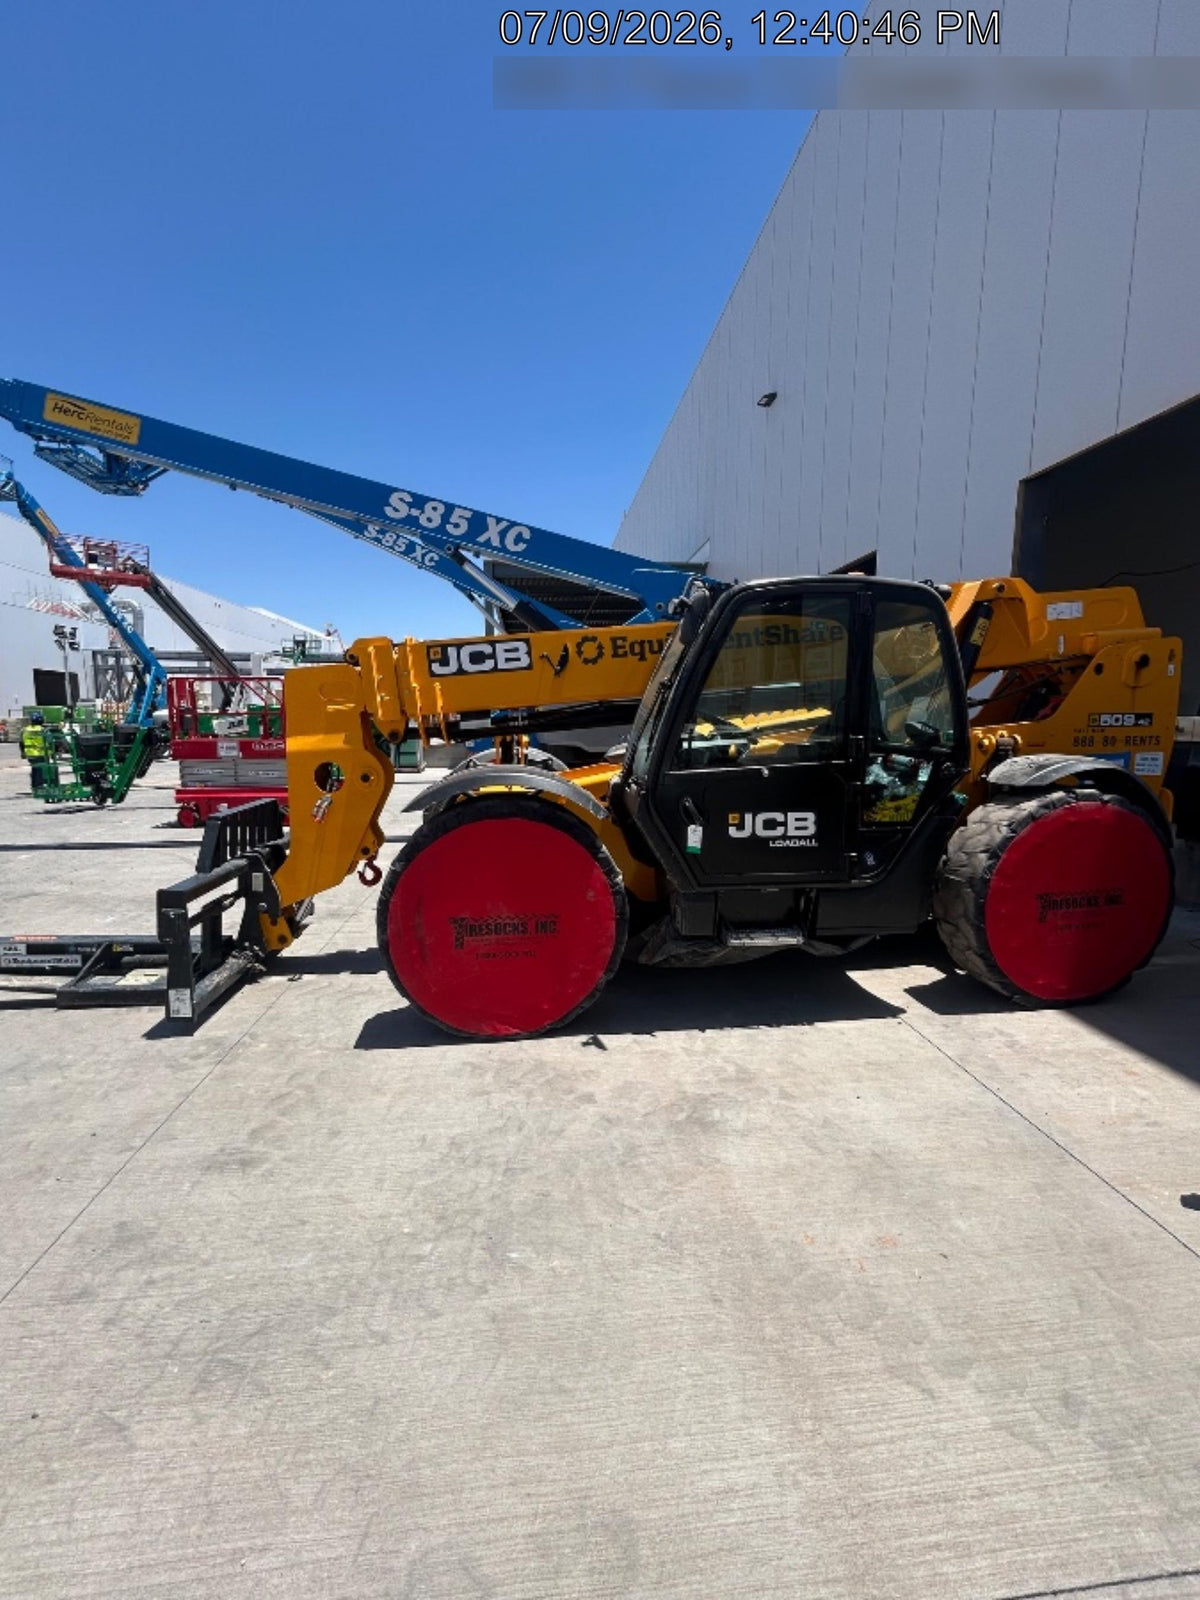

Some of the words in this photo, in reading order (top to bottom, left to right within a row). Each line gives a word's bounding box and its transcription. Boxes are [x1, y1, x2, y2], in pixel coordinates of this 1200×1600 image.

[383, 490, 474, 536] S-85
[476, 515, 532, 552] XC
[363, 523, 410, 552] S-85
[409, 546, 441, 567] XC
[430, 641, 531, 676] JCB
[1124, 734, 1161, 746] RENTS
[728, 811, 817, 839] JCB
[769, 838, 818, 847] LOADALL
